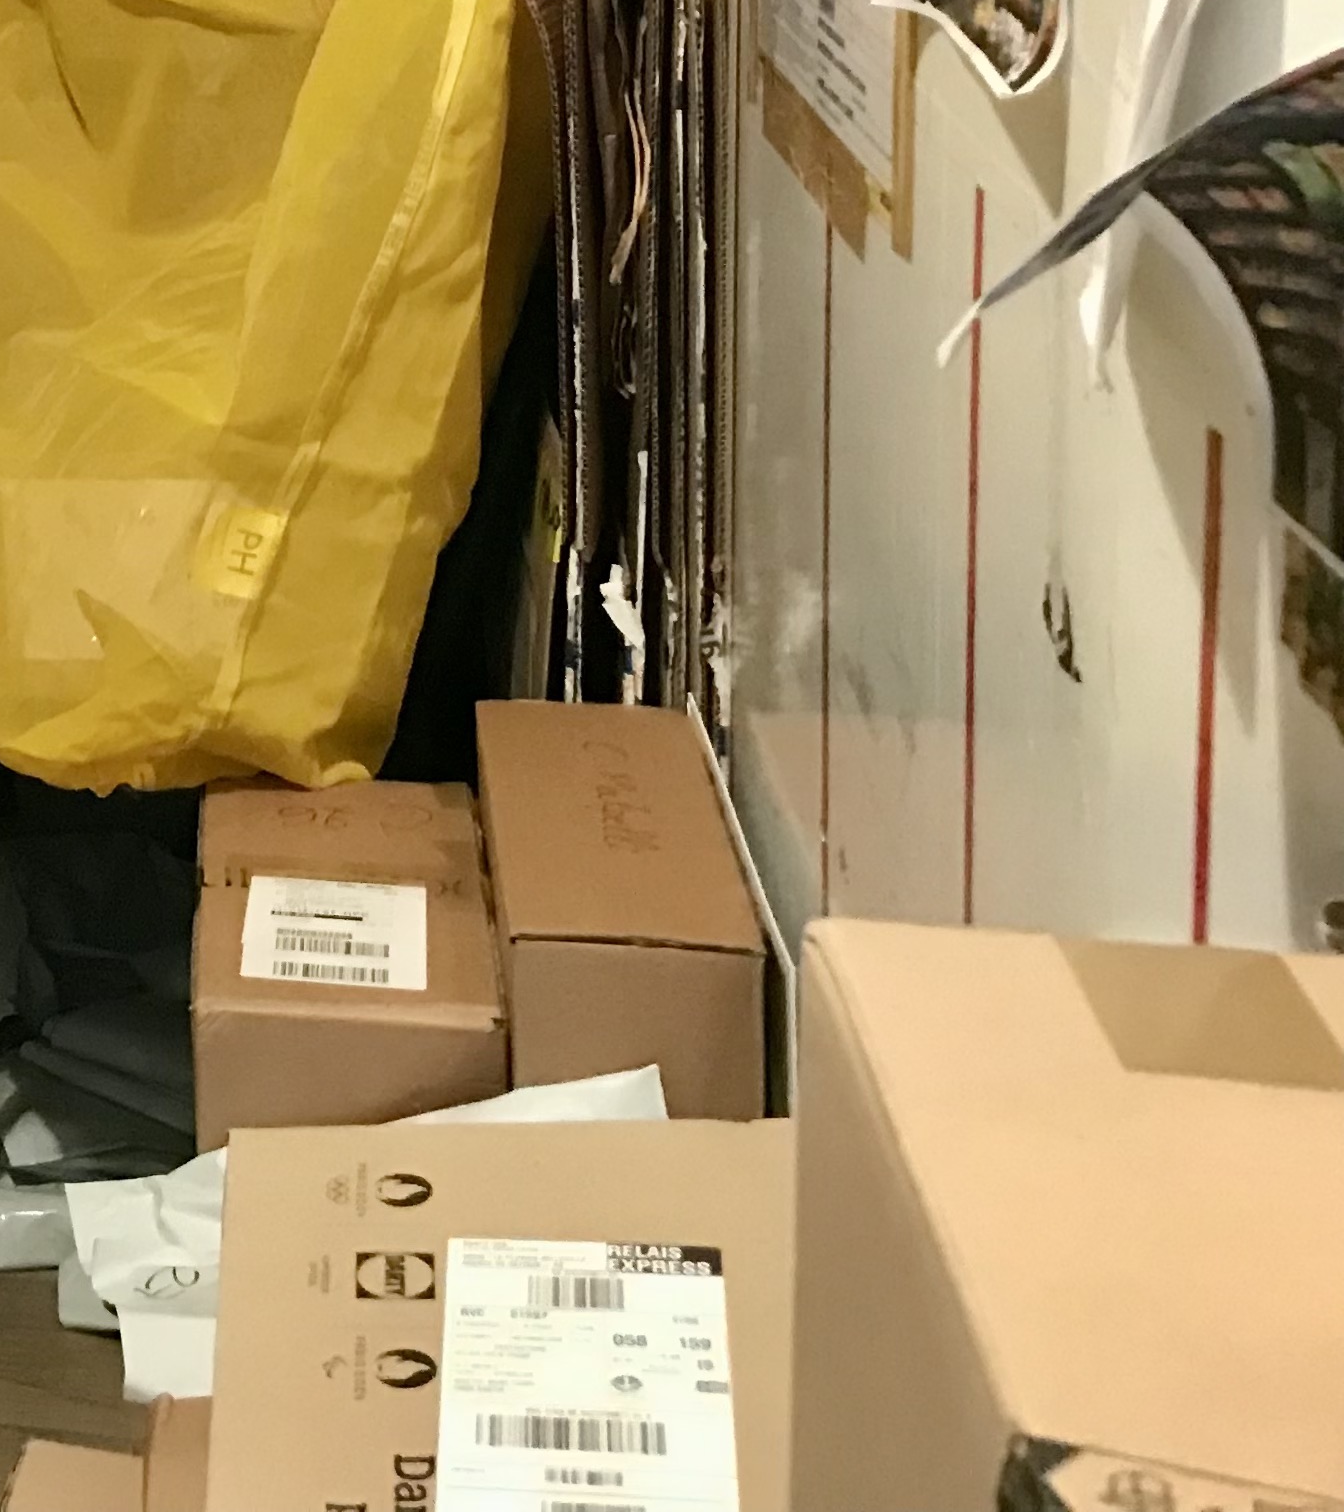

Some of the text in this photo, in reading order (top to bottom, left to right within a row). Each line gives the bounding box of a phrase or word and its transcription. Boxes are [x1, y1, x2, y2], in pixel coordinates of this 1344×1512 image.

[607, 1244, 683, 1260] RELAIS
[608, 1259, 712, 1275] EXPRESS
[384, 1255, 407, 1296] DARTY
